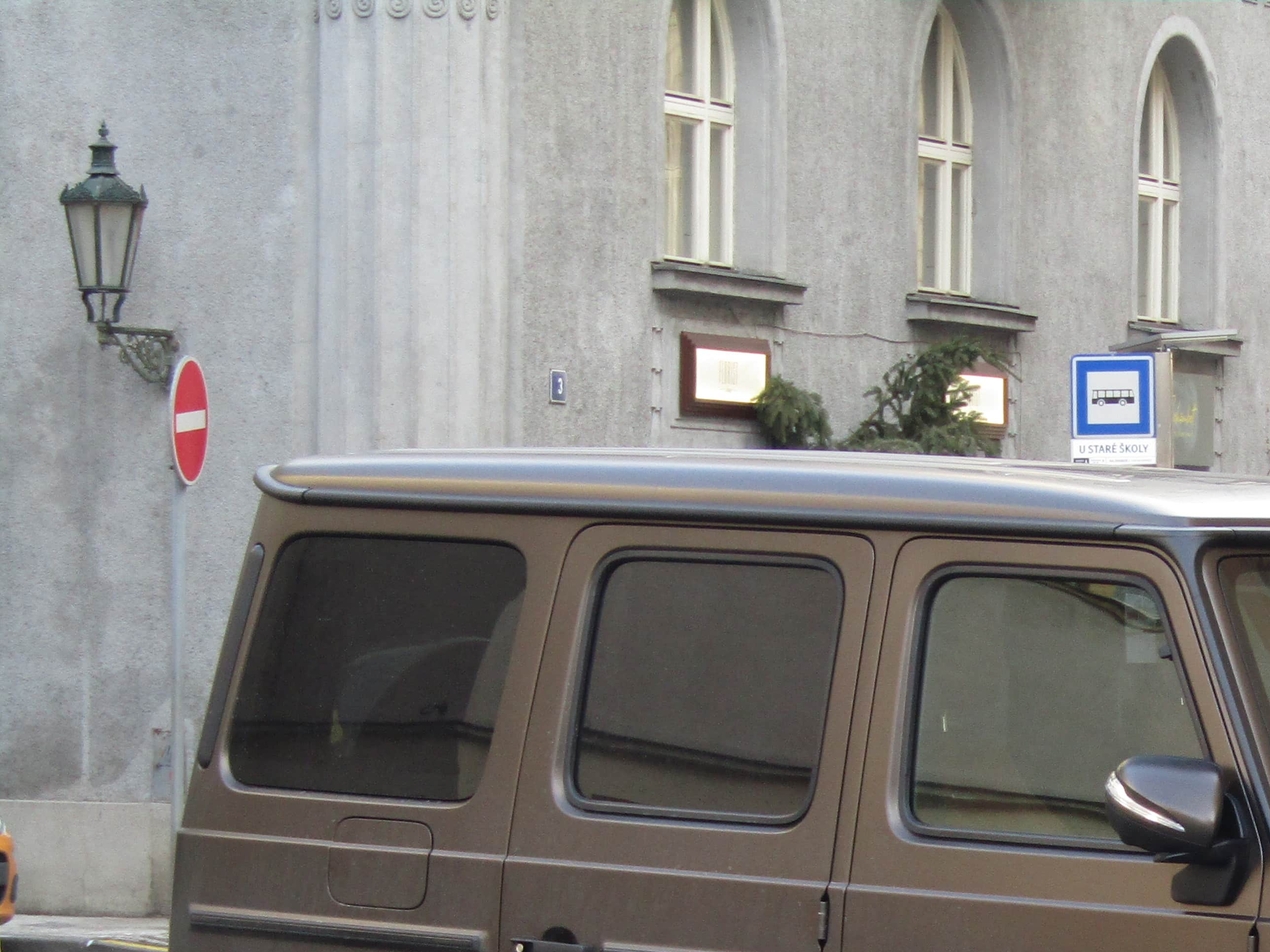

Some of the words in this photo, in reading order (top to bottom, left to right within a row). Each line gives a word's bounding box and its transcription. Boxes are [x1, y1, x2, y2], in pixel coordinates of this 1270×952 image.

[1079, 445, 1086, 454] U
[1088, 443, 1117, 454] STARÉ
[1119, 442, 1149, 454] ŠKOLY
